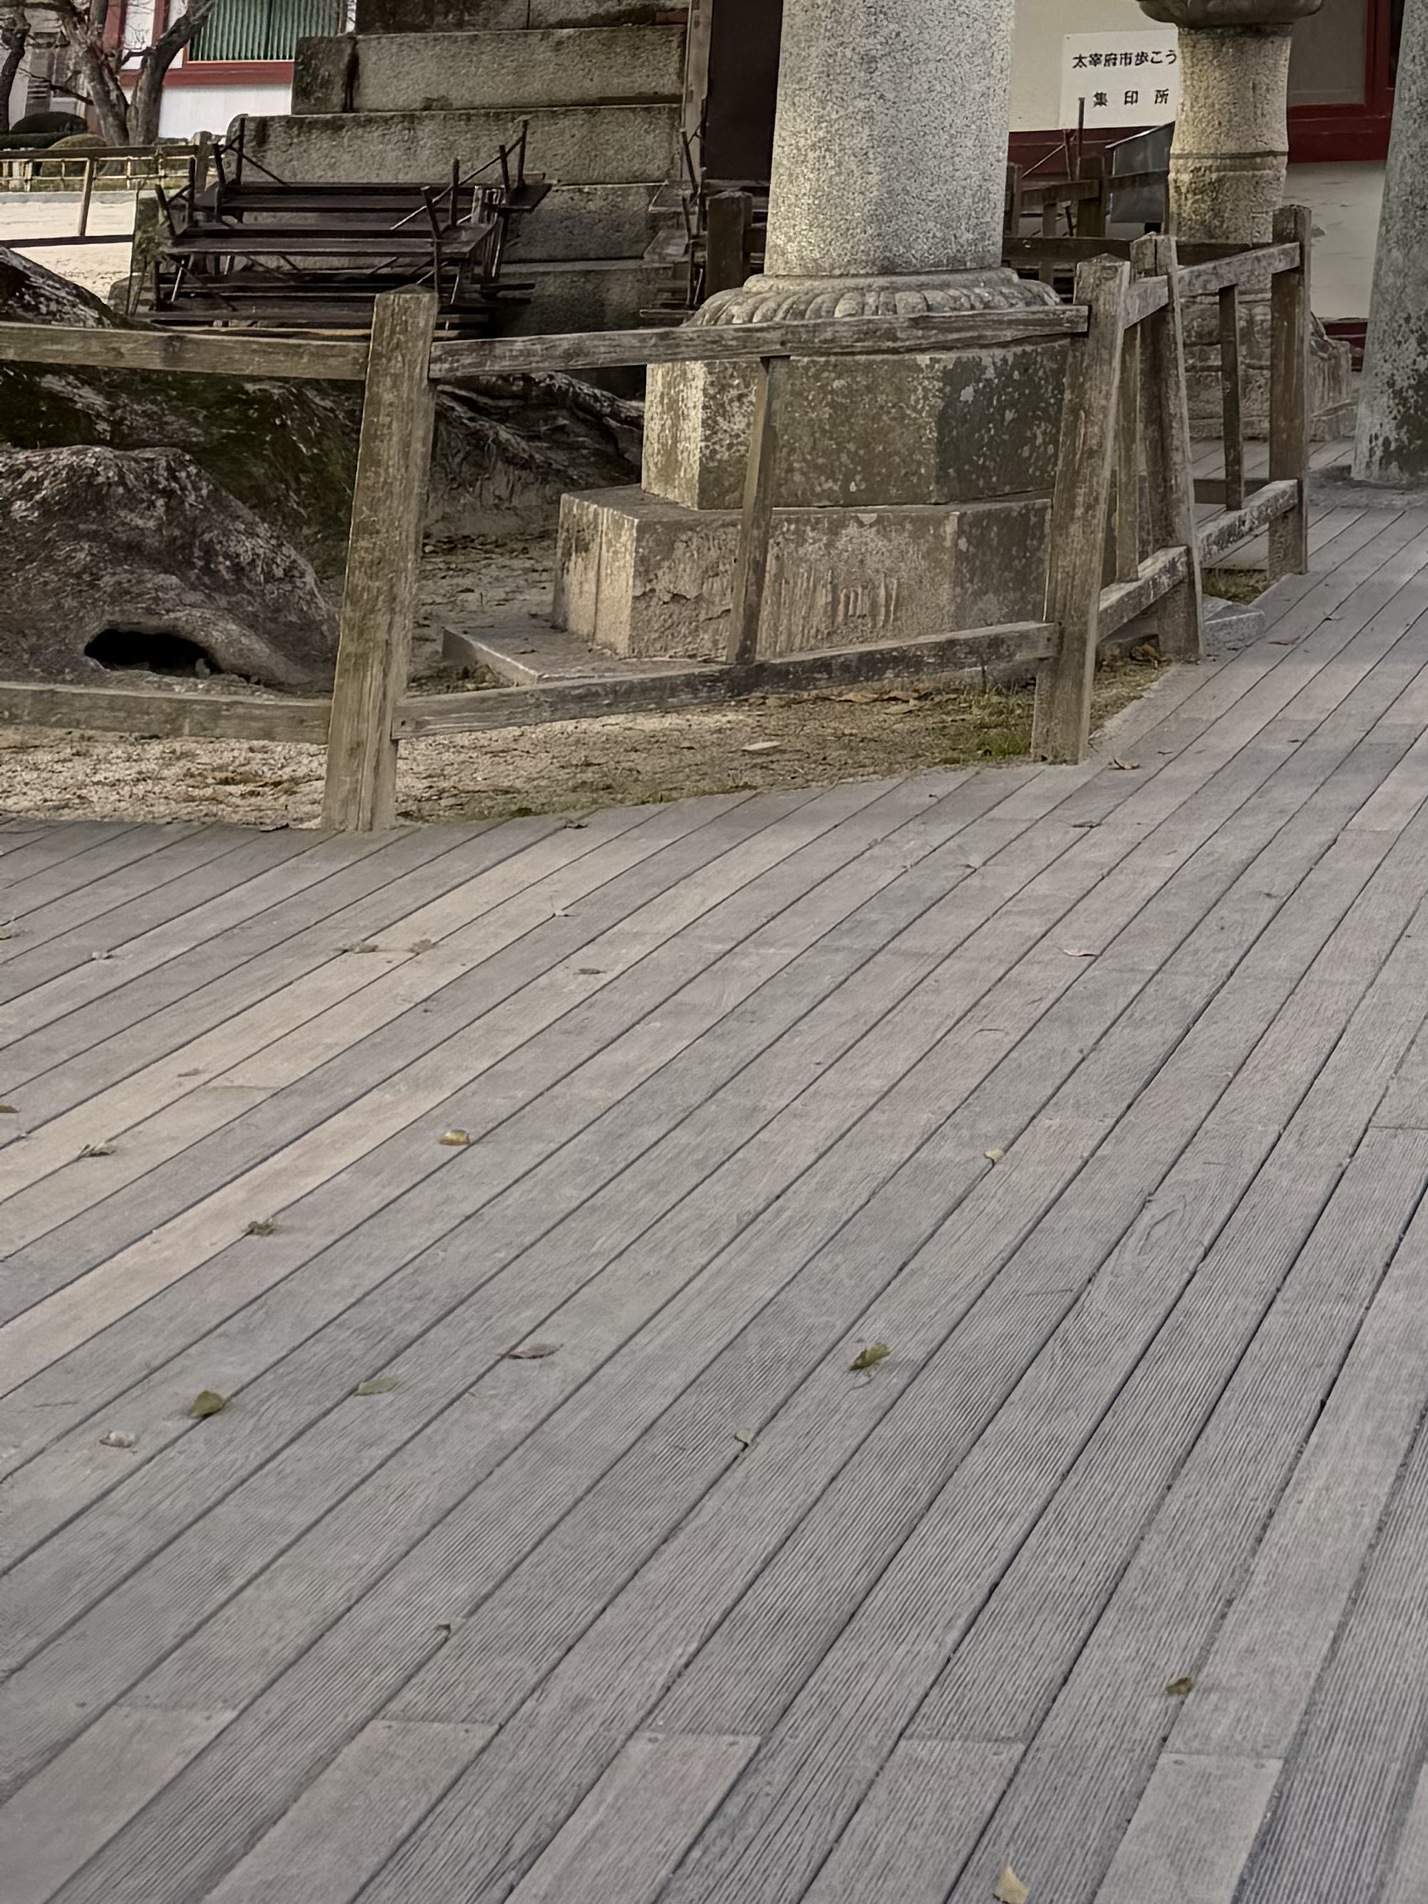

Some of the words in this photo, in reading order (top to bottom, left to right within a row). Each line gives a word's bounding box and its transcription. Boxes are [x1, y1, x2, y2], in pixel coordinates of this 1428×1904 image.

[1072, 50, 1177, 69] 太宰府市歩こう
